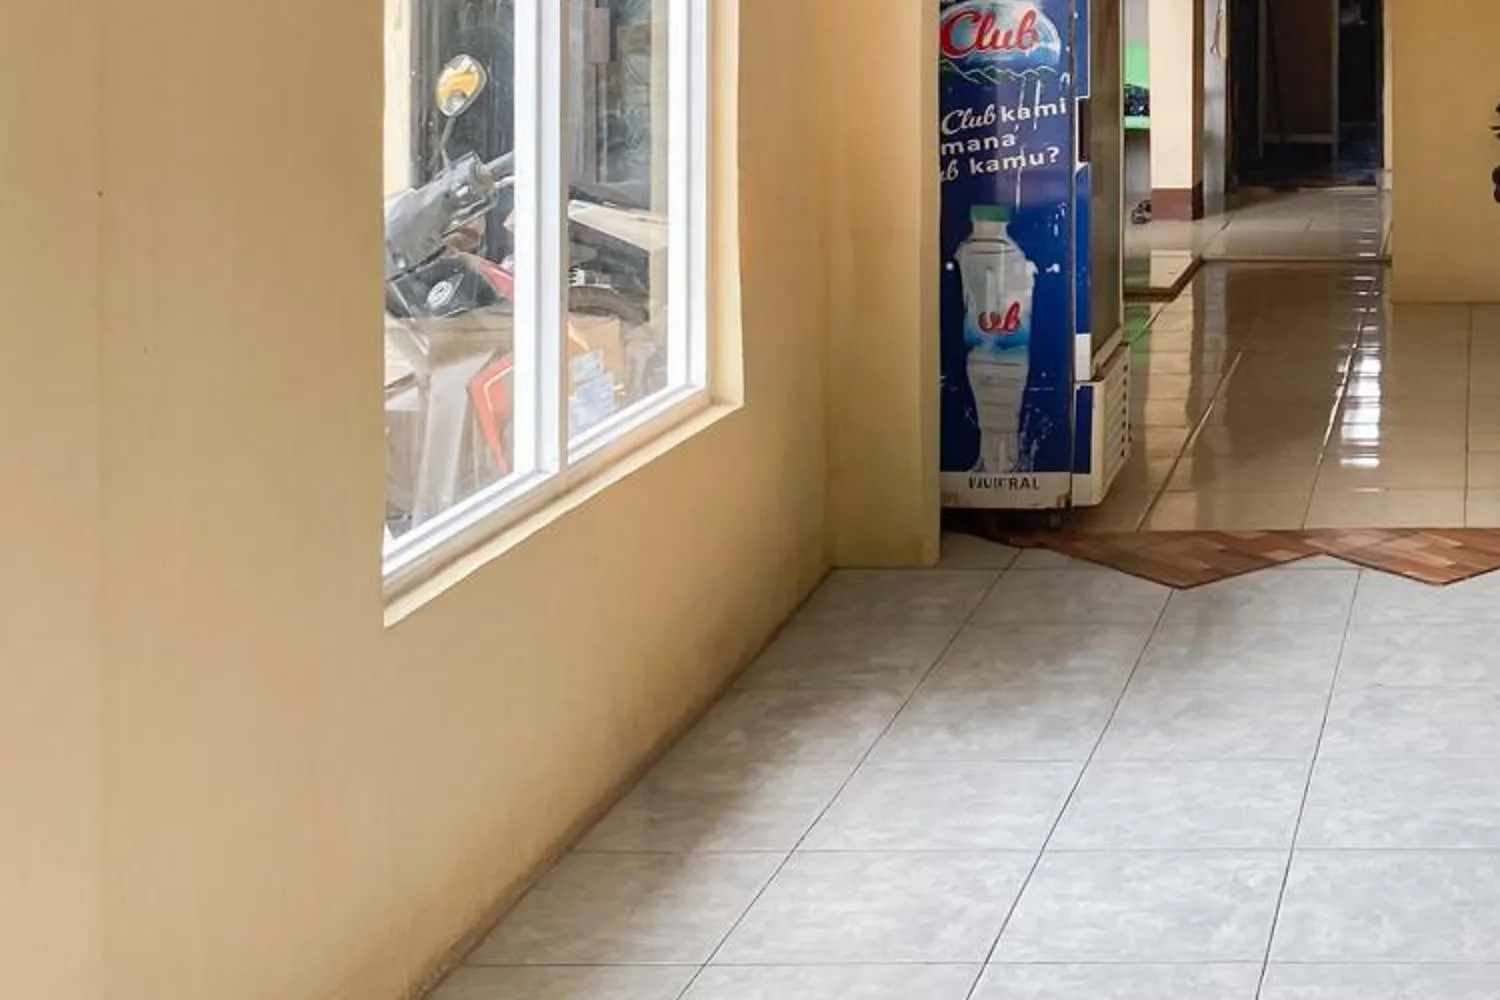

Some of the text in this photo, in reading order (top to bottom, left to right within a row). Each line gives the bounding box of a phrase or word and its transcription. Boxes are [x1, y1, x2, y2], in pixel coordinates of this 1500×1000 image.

[940, 8, 1039, 58] Club
[941, 97, 1068, 135] Club kami
[941, 133, 1016, 155] mana
[969, 146, 1060, 175] kamu?
